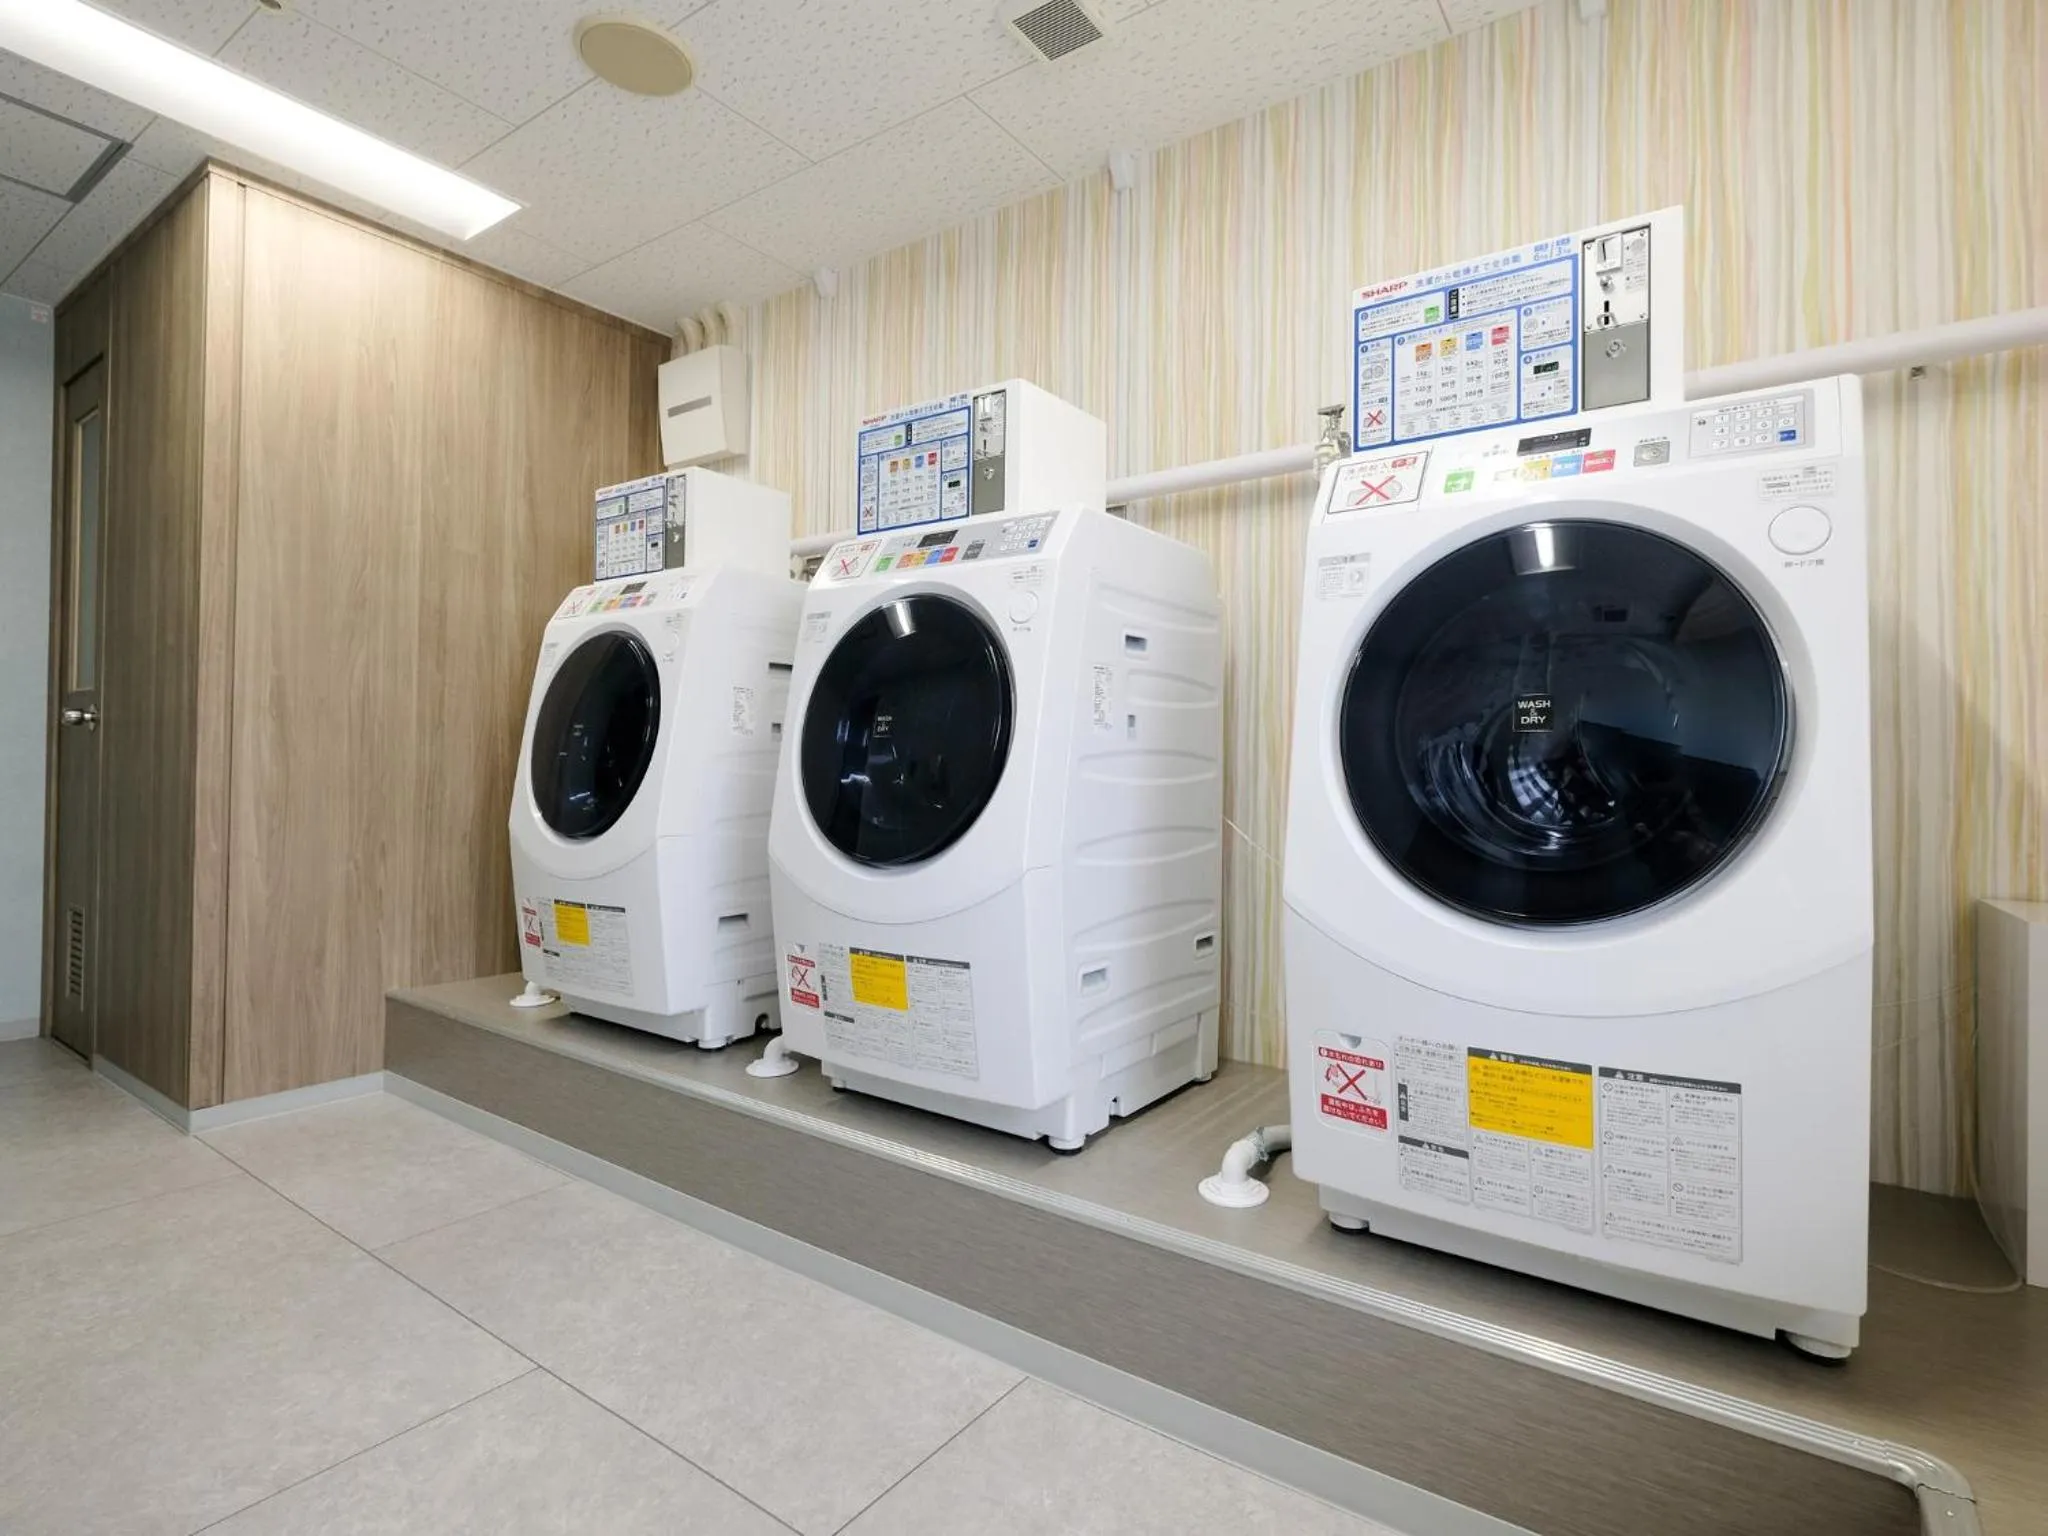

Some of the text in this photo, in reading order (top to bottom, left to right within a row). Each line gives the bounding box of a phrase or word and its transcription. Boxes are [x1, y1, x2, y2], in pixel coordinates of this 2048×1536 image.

[1361, 281, 1408, 300] SHARP
[1517, 700, 1551, 709] WASH
[1520, 715, 1546, 725] DRY
